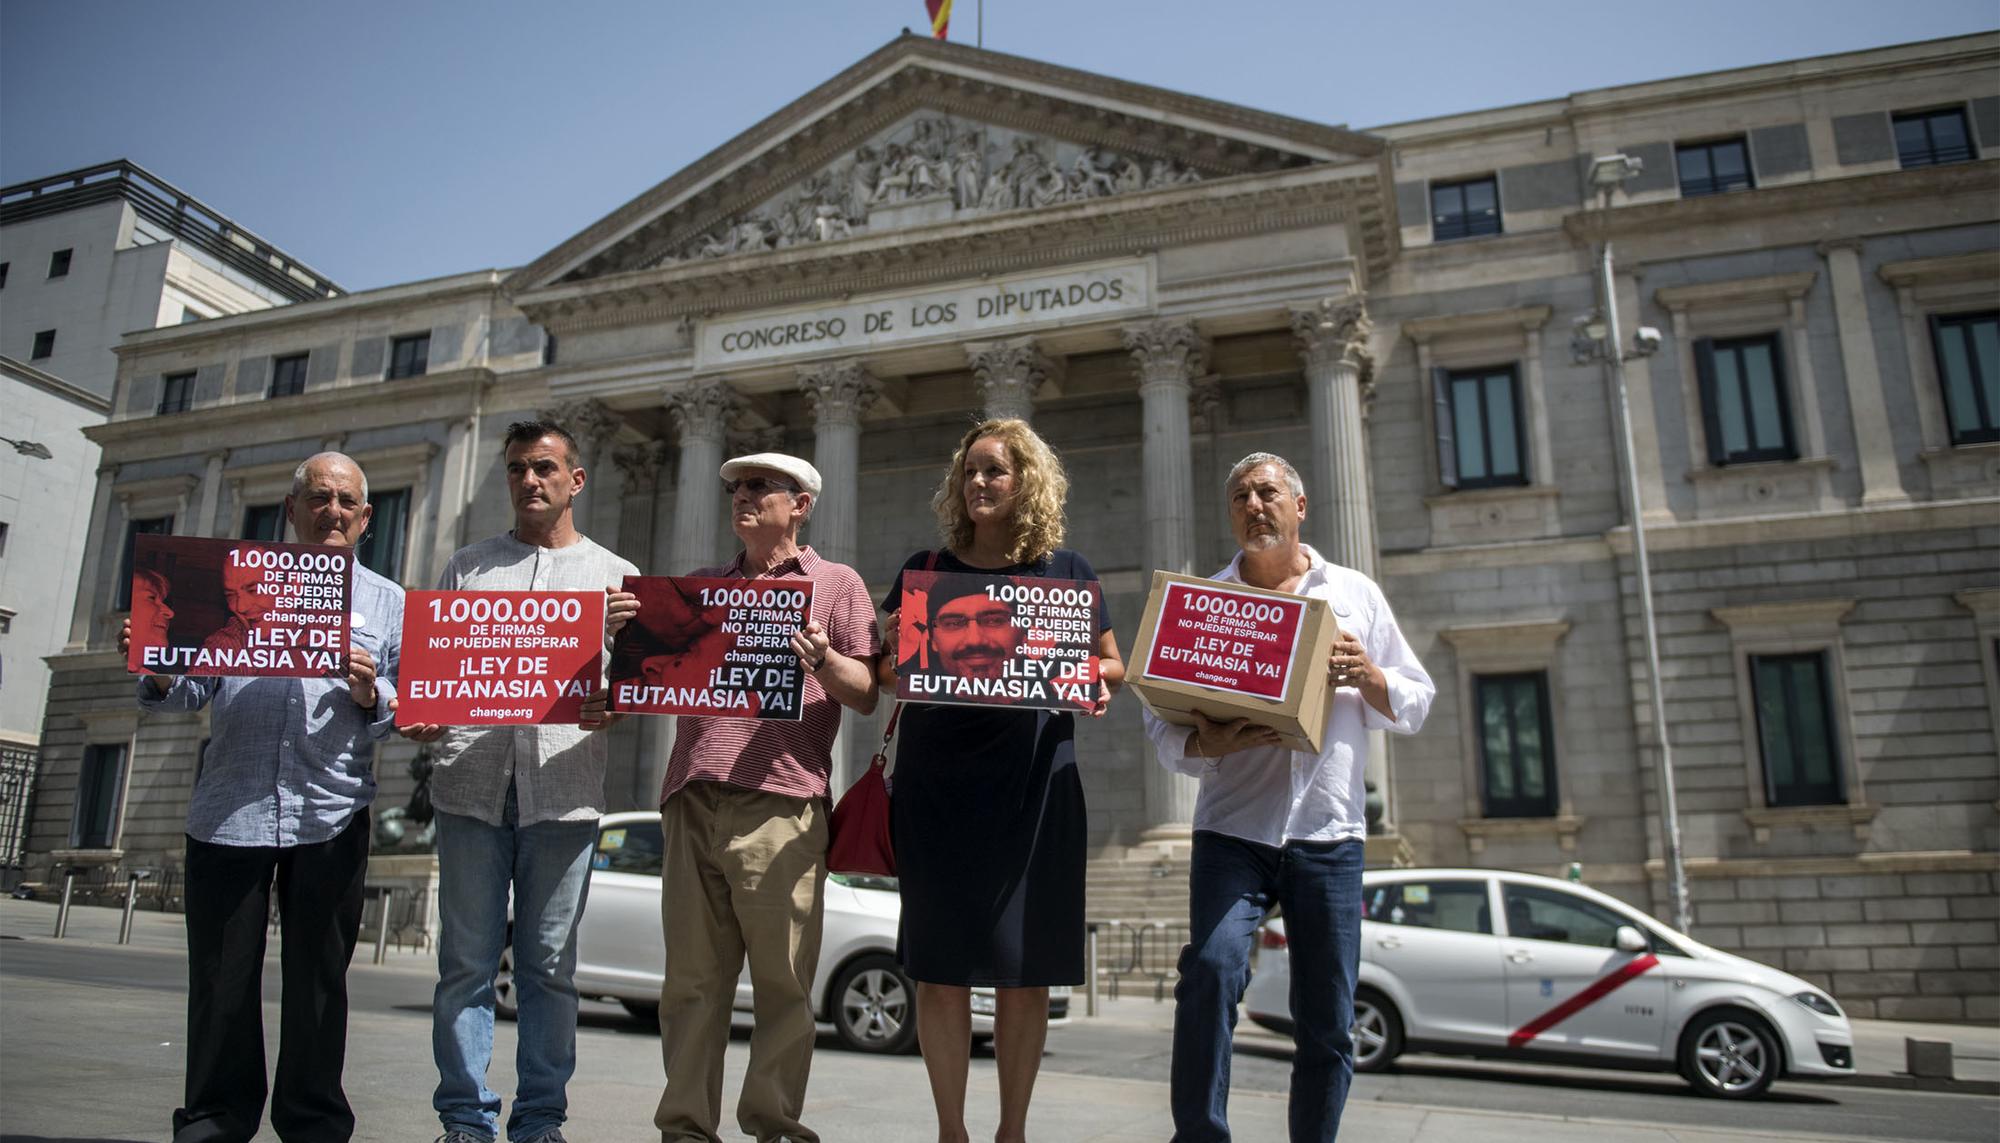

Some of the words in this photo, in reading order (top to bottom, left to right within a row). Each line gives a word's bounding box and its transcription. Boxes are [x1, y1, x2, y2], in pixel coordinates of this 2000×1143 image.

[721, 318, 846, 352] CONGRESO
[864, 311, 893, 334] DE
[911, 304, 957, 328] LOS
[977, 279, 1123, 320] DIPUTADOS
[229, 549, 345, 572] 1.000.000
[265, 571, 285, 582] DE
[289, 571, 343, 585] FIRMAS
[257, 584, 280, 595] NO
[284, 585, 342, 598] PUEDEN
[700, 588, 805, 608] 1.000.000
[985, 584, 1092, 606] 1.000.000
[275, 597, 342, 610] ESPERAR
[429, 598, 582, 623] 1.000.000
[1017, 605, 1036, 616] DE
[1039, 606, 1090, 619] FIRMAS
[1183, 593, 1284, 623] 1.000.000
[264, 611, 341, 626] change.org
[729, 609, 746, 620] DE
[750, 610, 802, 622] FIRMAS
[1011, 617, 1031, 628] NO
[1035, 618, 1090, 631] PUEDEN
[1206, 614, 1219, 623] DE
[1221, 617, 1256, 629] FIRMAS
[248, 628, 306, 647] ¡LEY
[310, 630, 340, 647] DE
[470, 625, 488, 635] DE
[493, 625, 545, 635] FIRMAS
[722, 622, 741, 633] NO
[746, 623, 800, 635] PUEDEN
[1028, 629, 1090, 643] ESPERAR
[1178, 619, 1192, 628] NO
[1194, 622, 1232, 635] PUEDEN
[1234, 628, 1277, 642] ESPERAR
[429, 638, 450, 648] NO
[454, 638, 510, 648] PUEDEN
[515, 637, 578, 648] ESPERAR
[737, 636, 796, 648] ESPERA
[1194, 637, 1229, 651] ¡LEY
[1232, 642, 1254, 657] DE
[144, 647, 295, 669] EUTANASIA
[302, 651, 340, 669] YA!
[725, 651, 796, 666] change.org
[1016, 643, 1089, 660] change.org
[460, 657, 511, 677] ¡LEY
[518, 657, 548, 674] DE
[1003, 659, 1053, 678] ¡LEY
[1061, 662, 1090, 680] DE
[1160, 646, 1249, 673] EUTANASIA
[1255, 662, 1280, 678] YA!
[709, 668, 759, 687] ¡LEY
[765, 670, 795, 688] DE
[1196, 671, 1237, 685] change.org
[410, 680, 547, 699] EUTANASIA
[554, 680, 590, 697] YA!
[910, 674, 1046, 699] EUTANASIA
[1053, 682, 1090, 701] YA!
[619, 685, 749, 708] EUTANASIA
[757, 691, 793, 711] YA!
[470, 707, 532, 718] change.org
